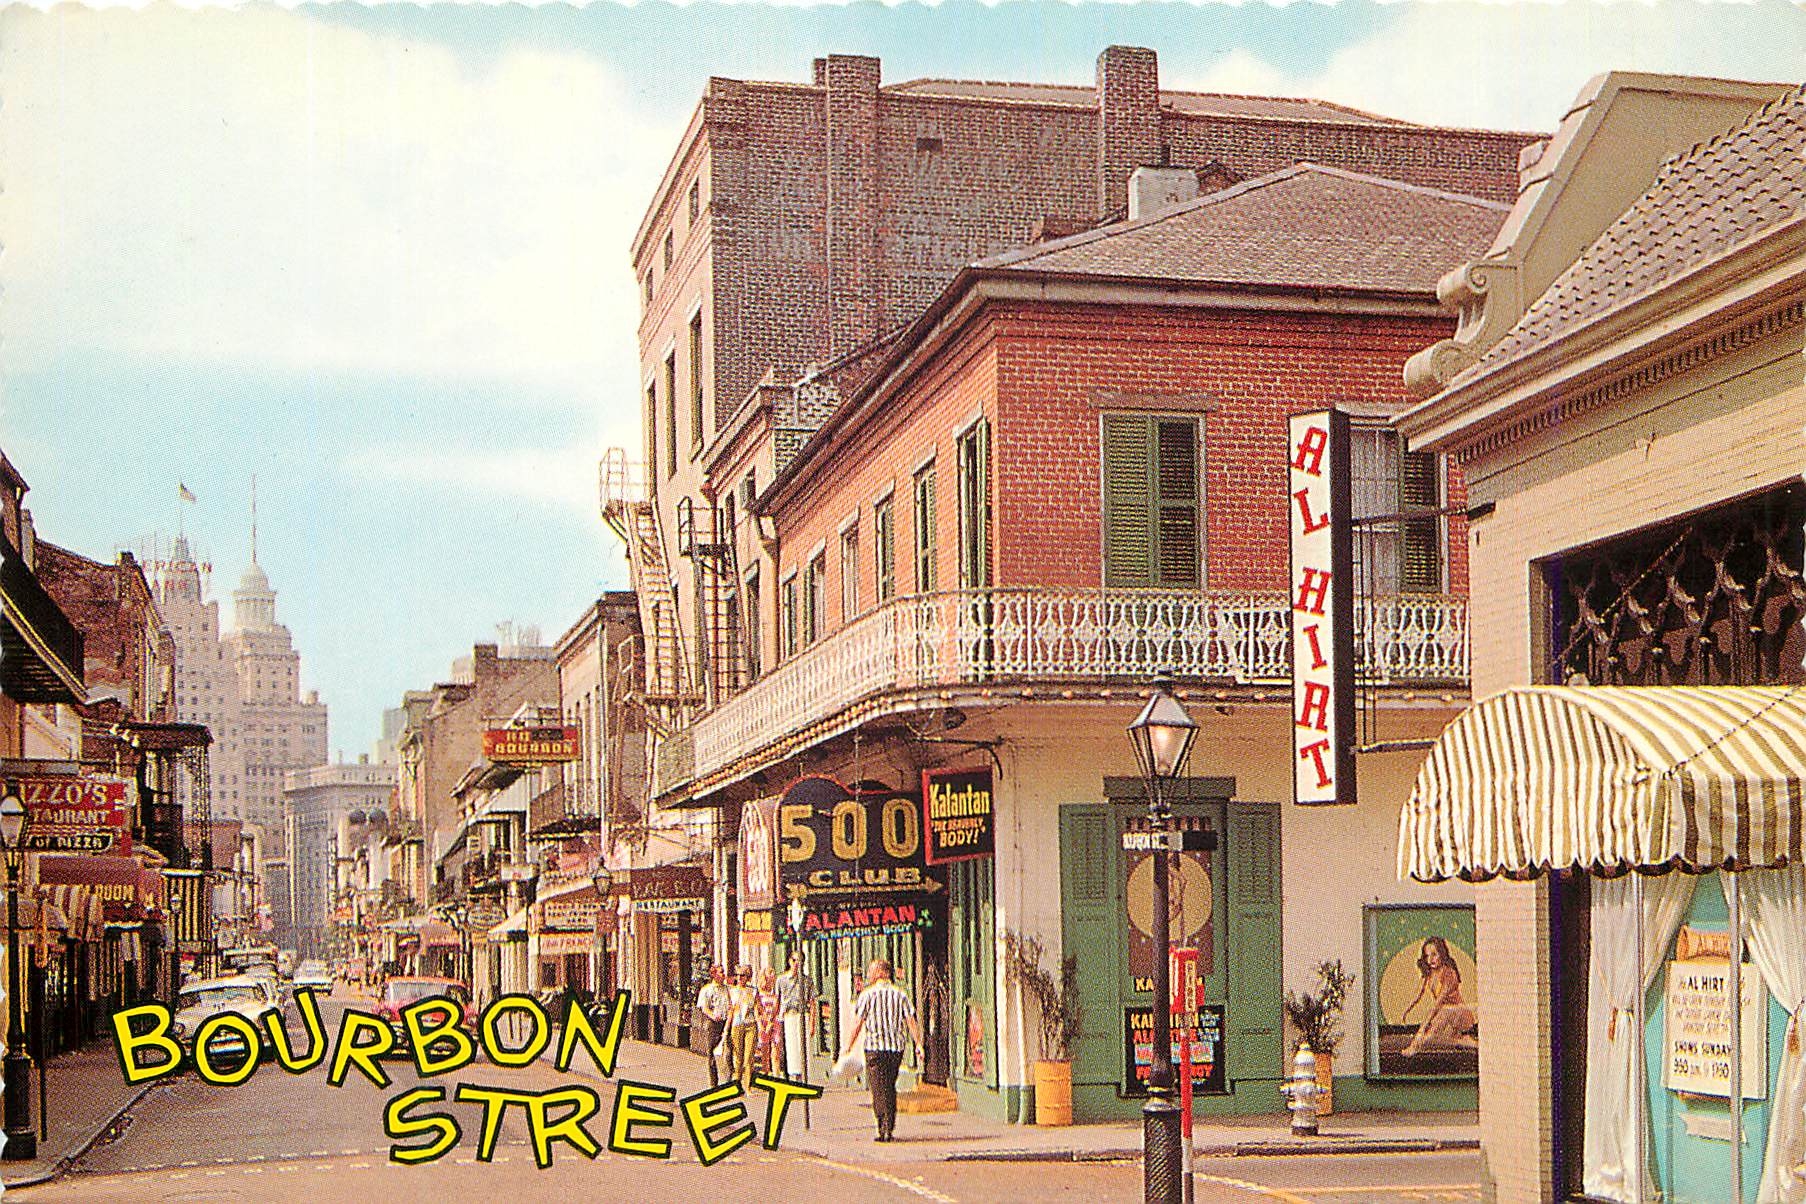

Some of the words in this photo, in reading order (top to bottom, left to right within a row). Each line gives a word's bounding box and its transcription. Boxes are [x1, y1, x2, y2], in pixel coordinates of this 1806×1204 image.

[1291, 426, 1331, 536] AL
[1292, 566, 1333, 789] HIRT
[929, 783, 990, 819] Kalantan
[782, 798, 919, 863] 500
[809, 867, 920, 887] CLUB
[1688, 976, 1699, 990] AL
[1701, 976, 1724, 991] HIRT
